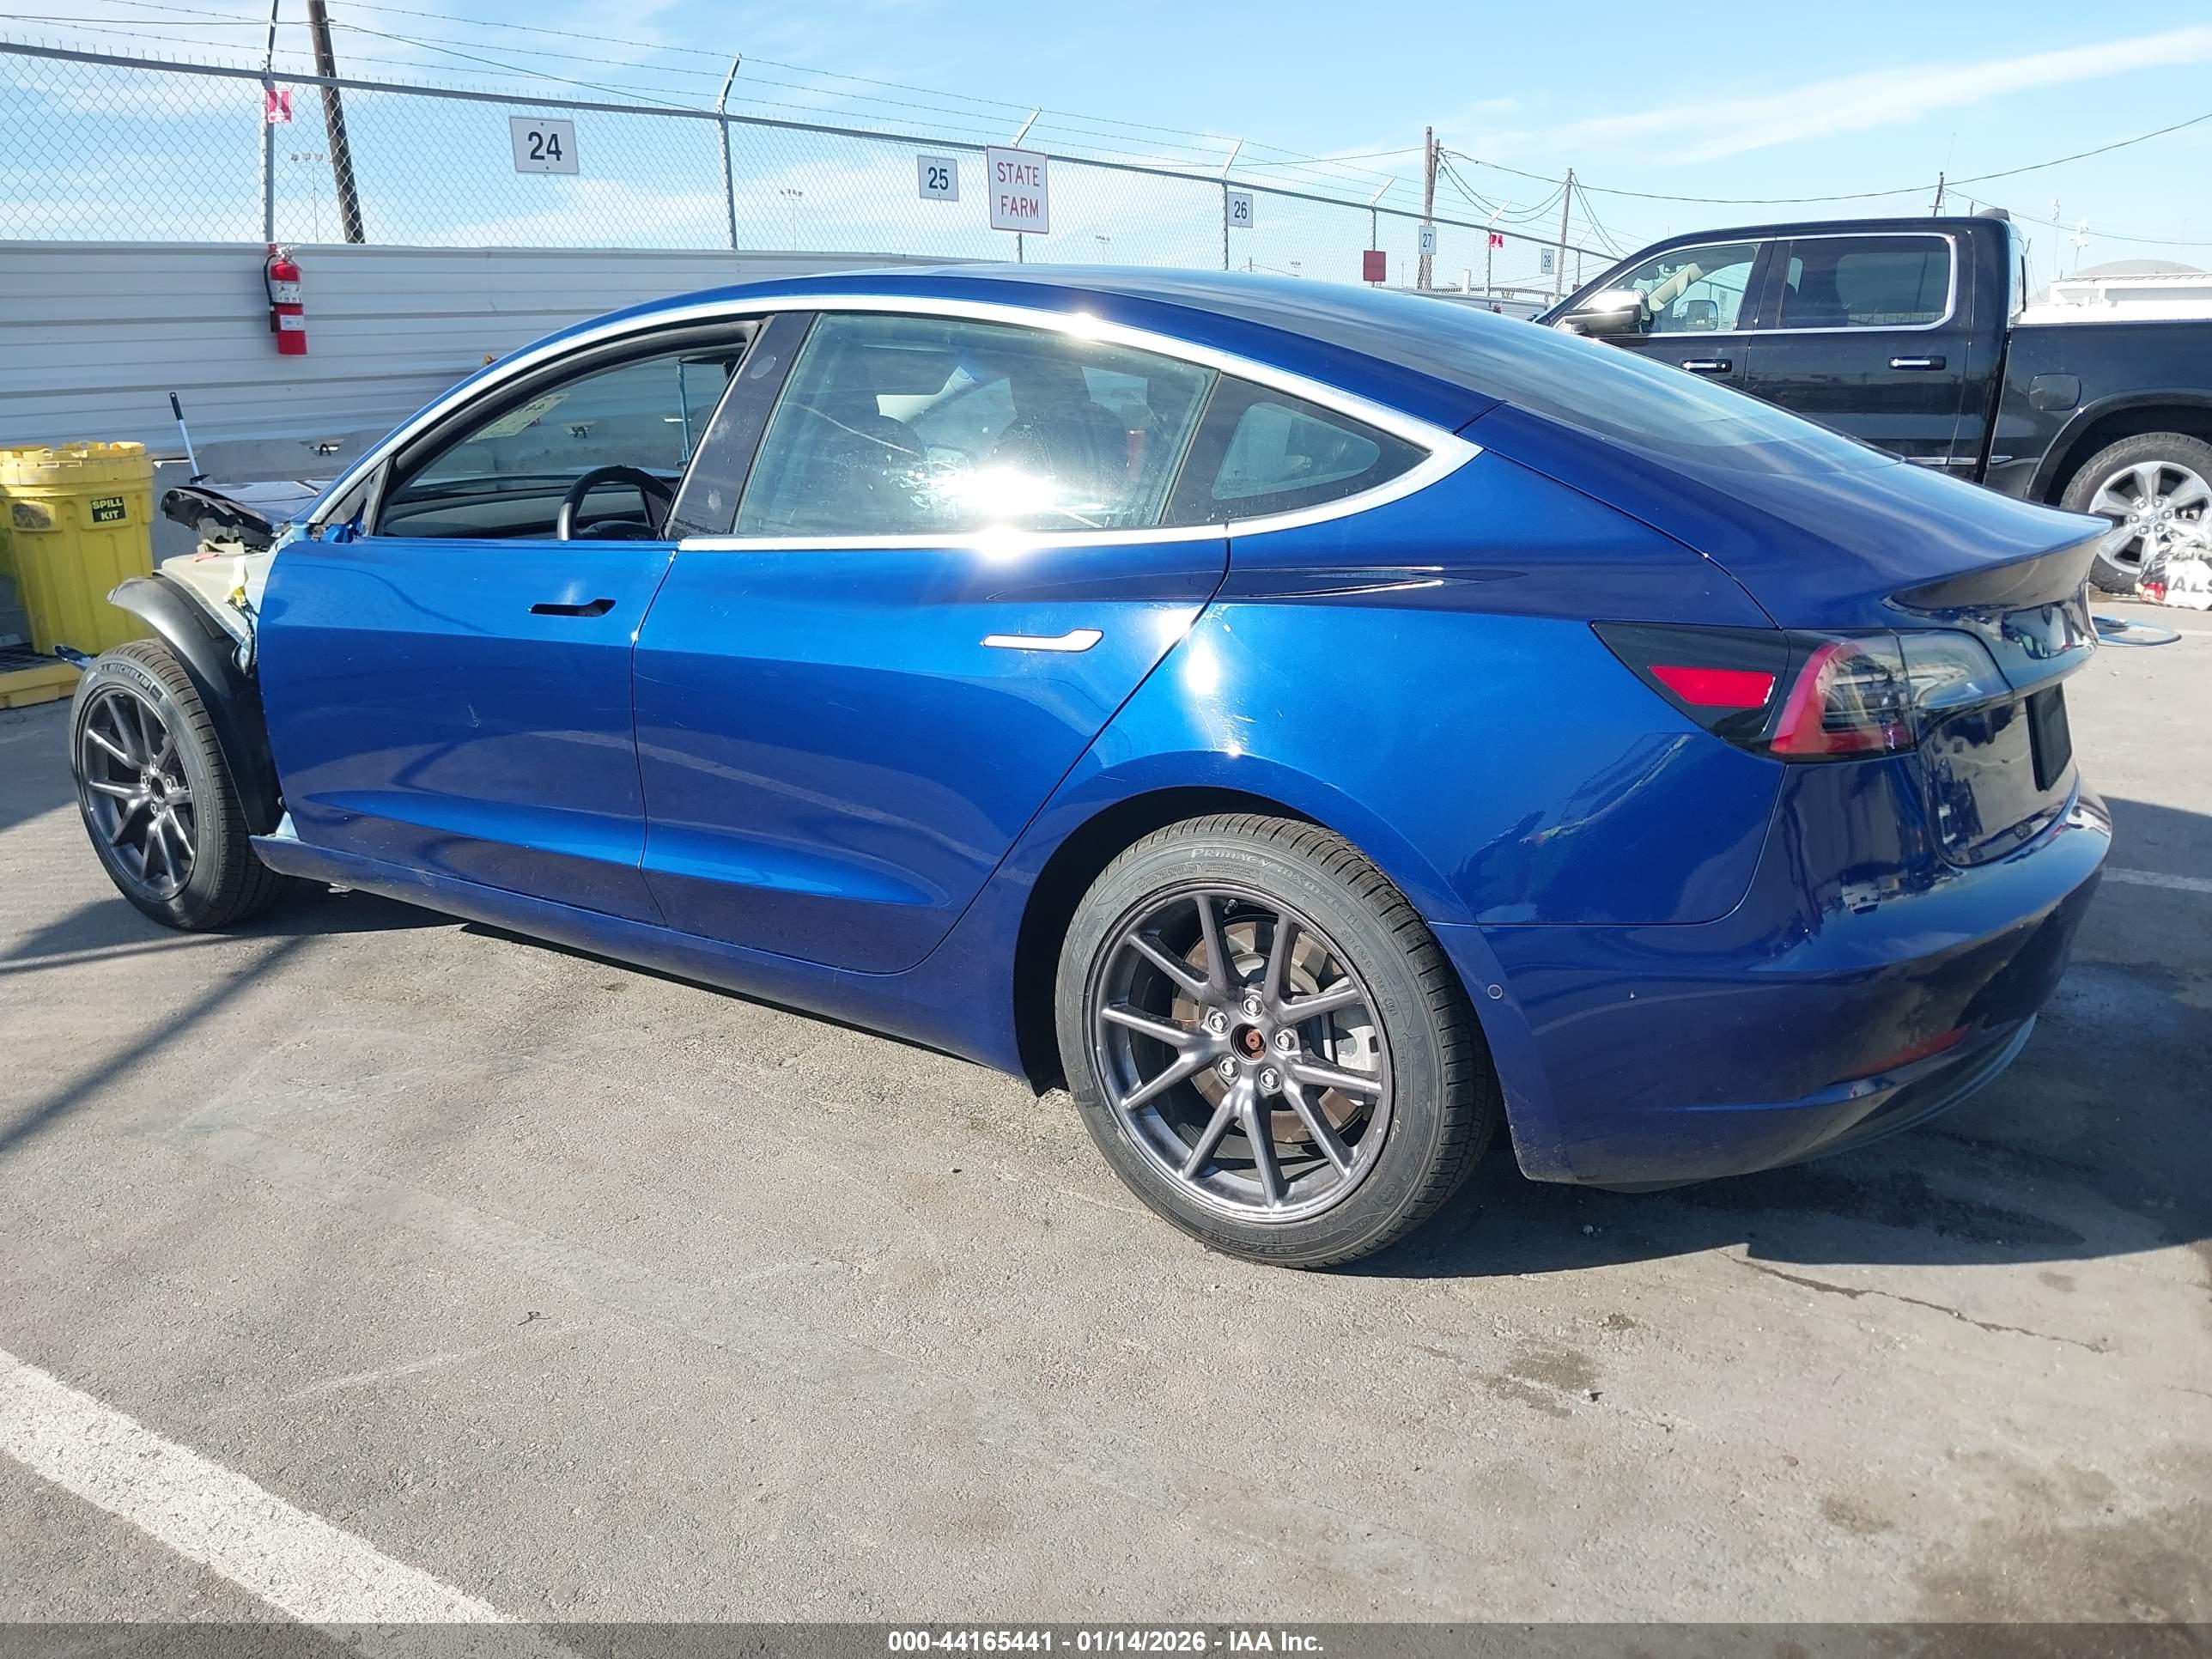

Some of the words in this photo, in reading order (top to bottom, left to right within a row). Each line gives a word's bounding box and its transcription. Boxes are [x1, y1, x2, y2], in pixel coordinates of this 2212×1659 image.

[527, 131, 563, 161] 24
[927, 167, 949, 191] 25
[997, 161, 1041, 187] STATE
[1000, 195, 1040, 219] FARM
[1234, 200, 1248, 220] 26
[1423, 233, 1433, 248] 27
[1543, 255, 1552, 267] 28
[92, 498, 124, 510] SPILL
[100, 510, 119, 520] KIT
